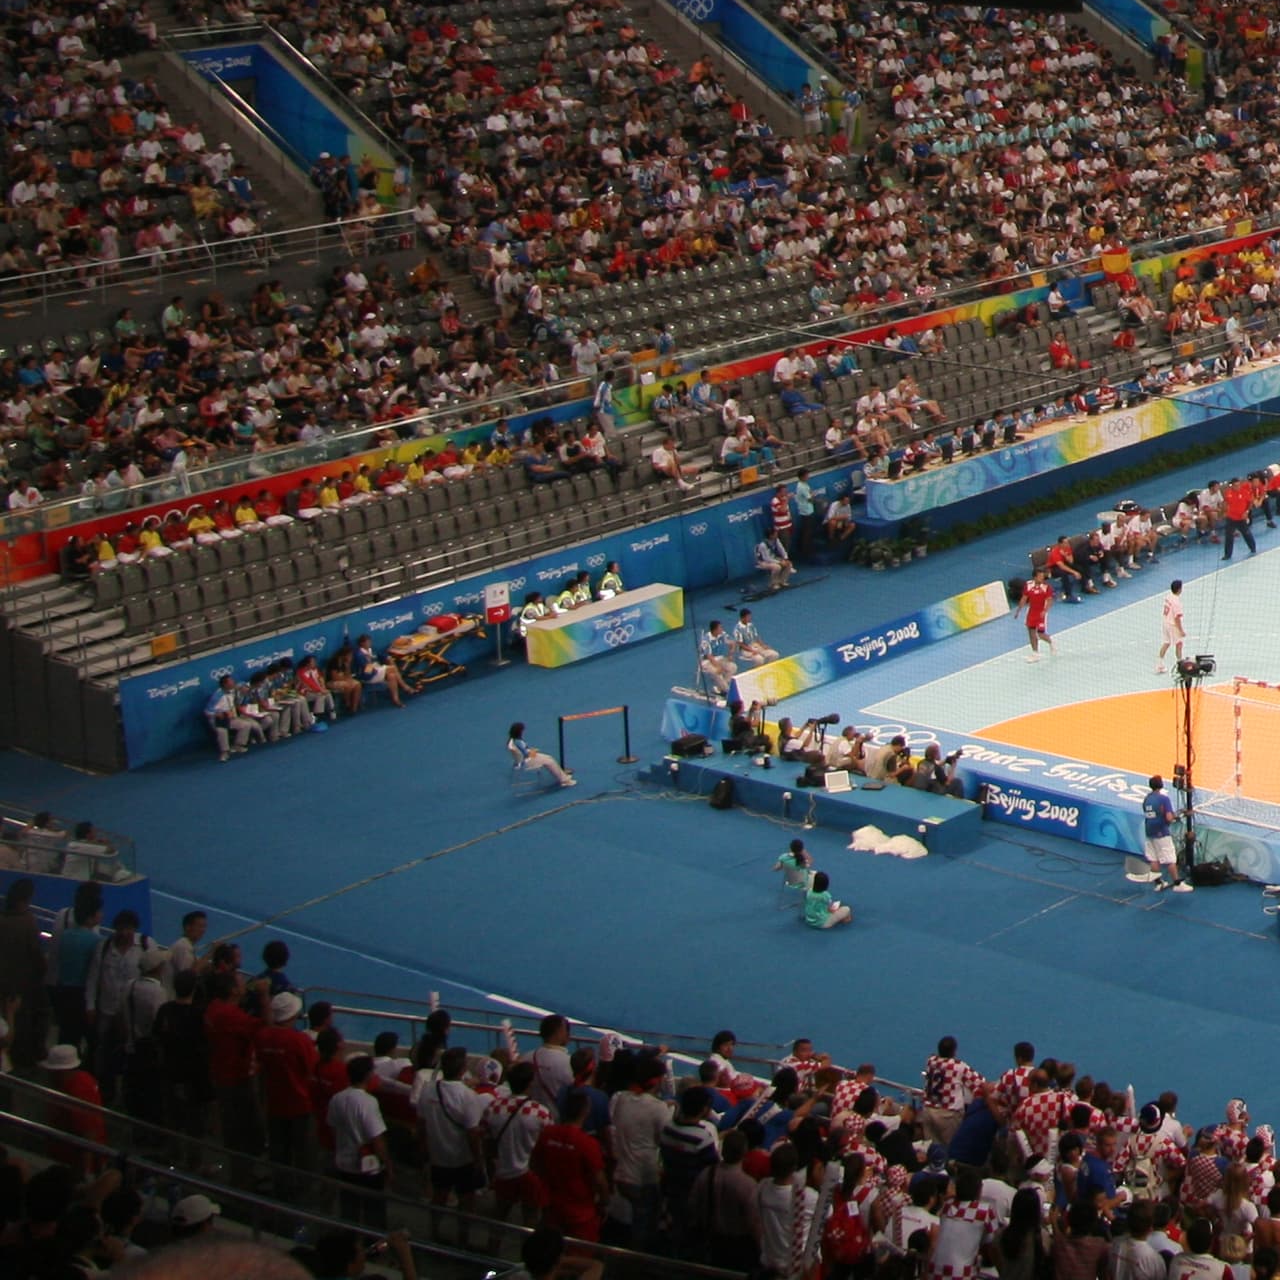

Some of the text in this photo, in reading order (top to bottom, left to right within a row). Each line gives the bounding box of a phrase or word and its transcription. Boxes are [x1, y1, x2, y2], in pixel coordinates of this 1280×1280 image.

[630, 534, 669, 552] Beijing 2008
[536, 562, 579, 581] Beijing 2008
[367, 612, 414, 631] Beijing 2008
[837, 622, 920, 663] Beijing 2008
[244, 648, 294, 669] Beijing 2008
[147, 677, 200, 699] Beijing 2008
[982, 783, 1079, 827] Beijing 2008
